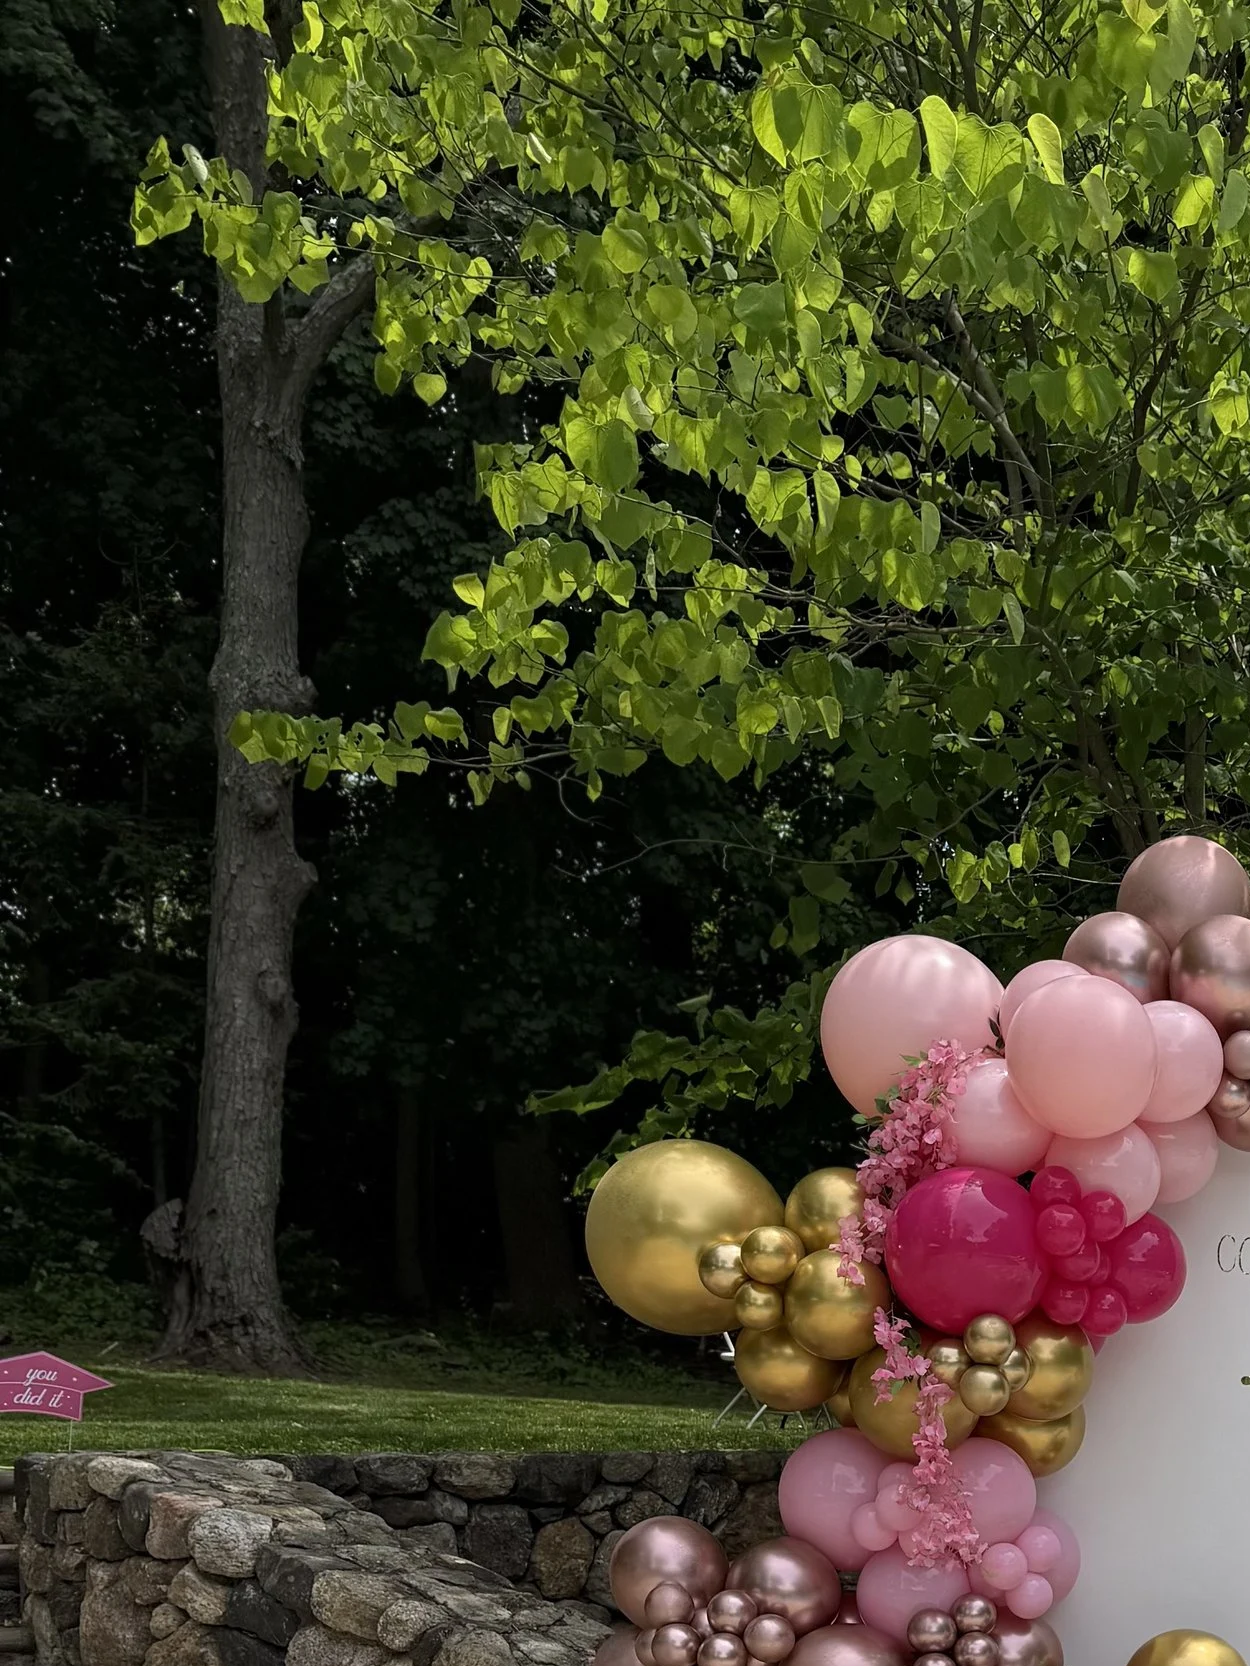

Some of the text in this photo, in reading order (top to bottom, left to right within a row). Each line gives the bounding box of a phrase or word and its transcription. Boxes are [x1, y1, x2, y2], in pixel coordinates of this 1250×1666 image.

[23, 1368, 58, 1386] you
[13, 1387, 64, 1408] did it
